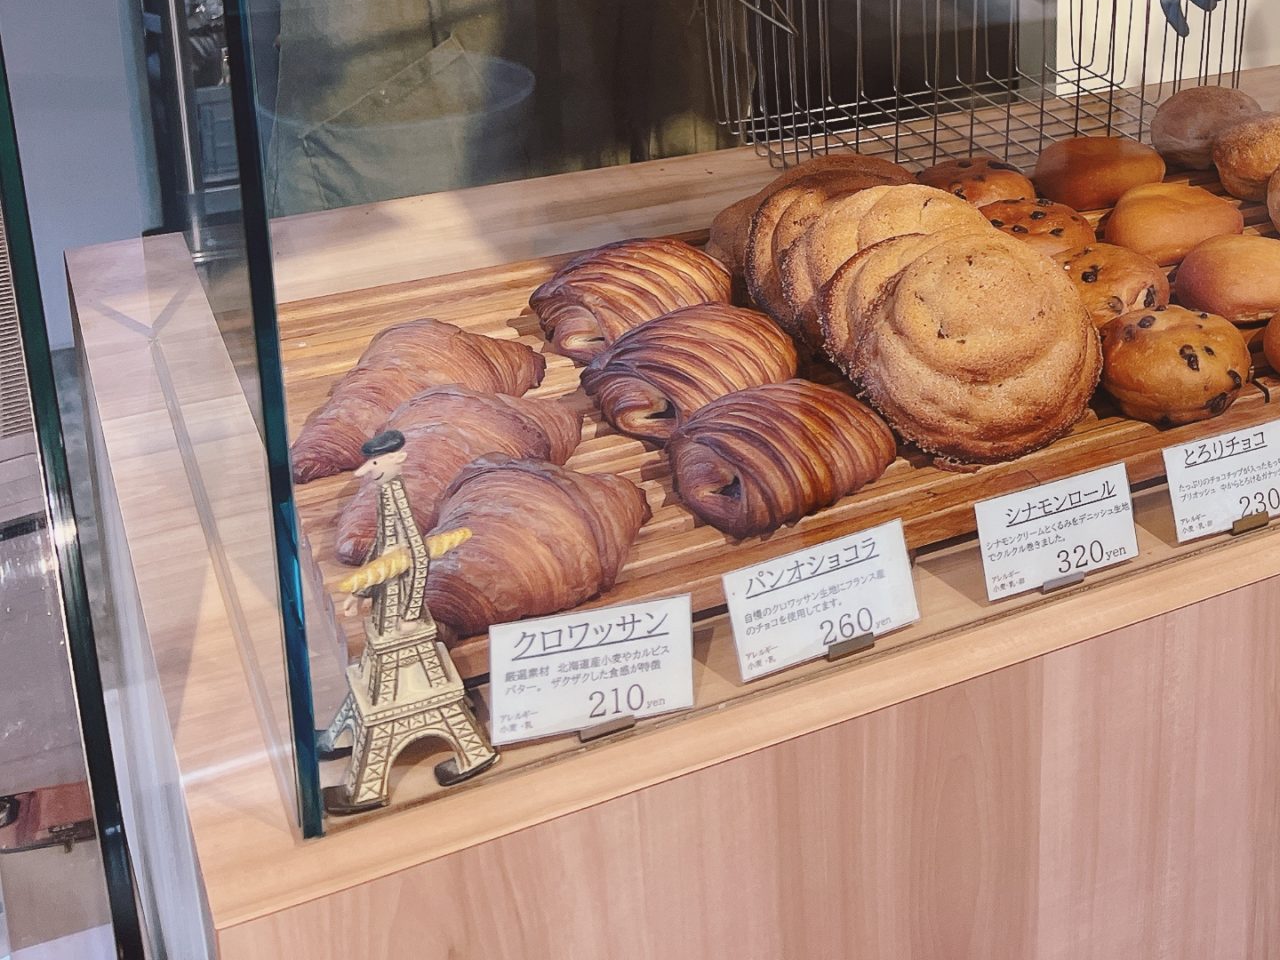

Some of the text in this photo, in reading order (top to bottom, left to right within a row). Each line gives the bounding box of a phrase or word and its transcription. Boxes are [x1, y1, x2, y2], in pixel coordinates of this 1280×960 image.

[1184, 431, 1266, 467] とろりチョコ
[1005, 480, 1116, 525] シナモンロール
[1180, 487, 1217, 502] ブリオッシュ
[1239, 487, 1280, 519] 230
[986, 501, 1131, 551] シナモンクリームとくるみをデニッシュ生地
[745, 537, 878, 596] パンオショコラ
[987, 534, 1066, 563] でクルクル巻きました。
[1056, 539, 1127, 574] 320 yen
[991, 570, 1021, 583] アレルギー
[744, 568, 886, 624] 自慢のクロワッサン生地にフランス産
[745, 598, 843, 636] のチョコを使用してます。
[819, 606, 892, 647] 260 yen
[513, 611, 669, 661] クロワッサン
[745, 644, 779, 661] アレルギー
[504, 644, 671, 683] 厳選素材 北海道産小麦やカルピス
[550, 659, 662, 689] ザクザクした食感が特徴
[500, 710, 540, 724] アレルギー
[588, 683, 666, 719] 210 yen
